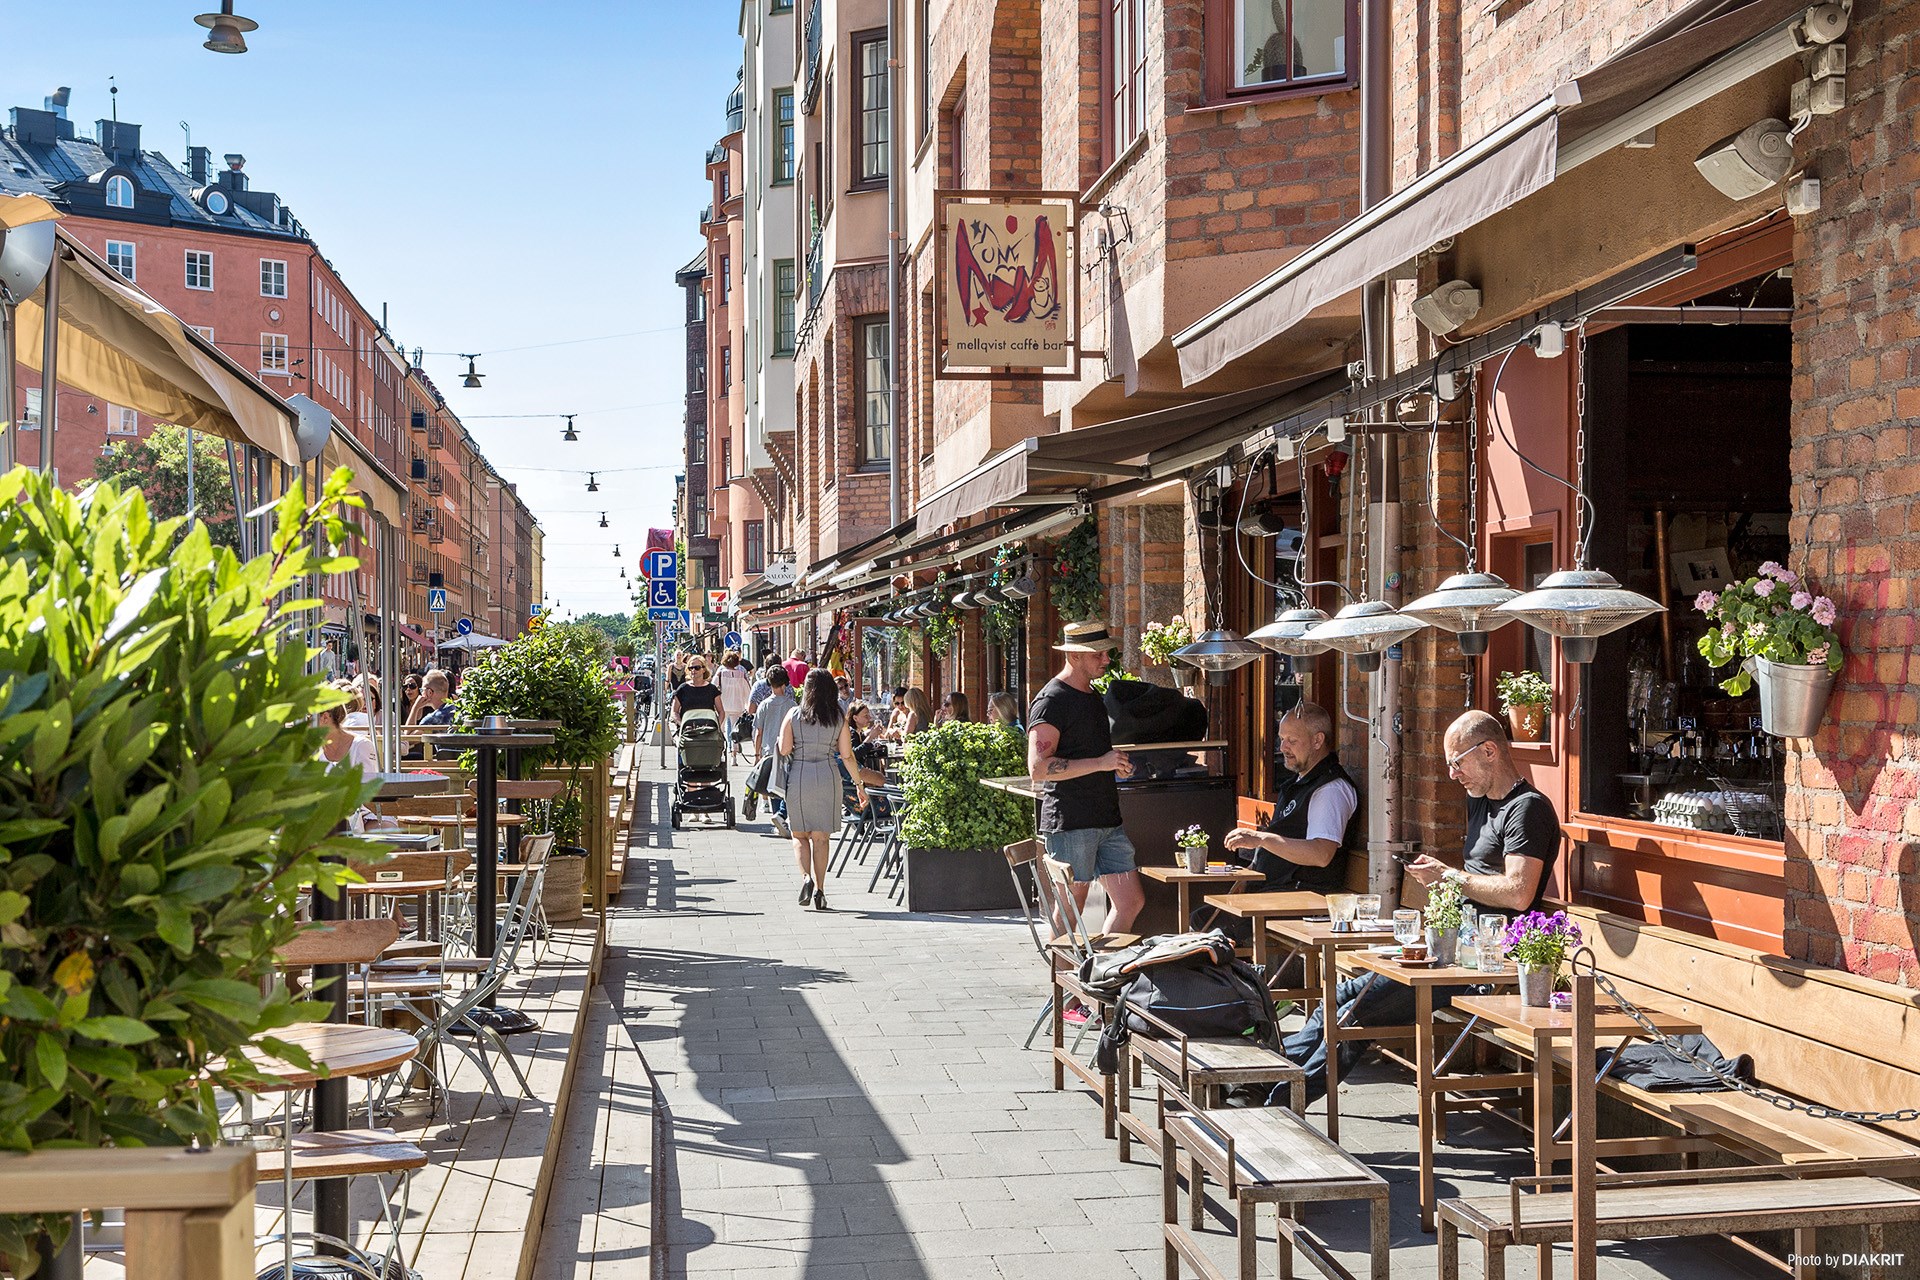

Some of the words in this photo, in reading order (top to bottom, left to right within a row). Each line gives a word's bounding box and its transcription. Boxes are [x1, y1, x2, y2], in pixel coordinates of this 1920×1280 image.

[957, 338, 1007, 353] mellqvist
[1010, 338, 1039, 350] caffè
[1043, 338, 1063, 350] bar
[657, 554, 673, 577] P
